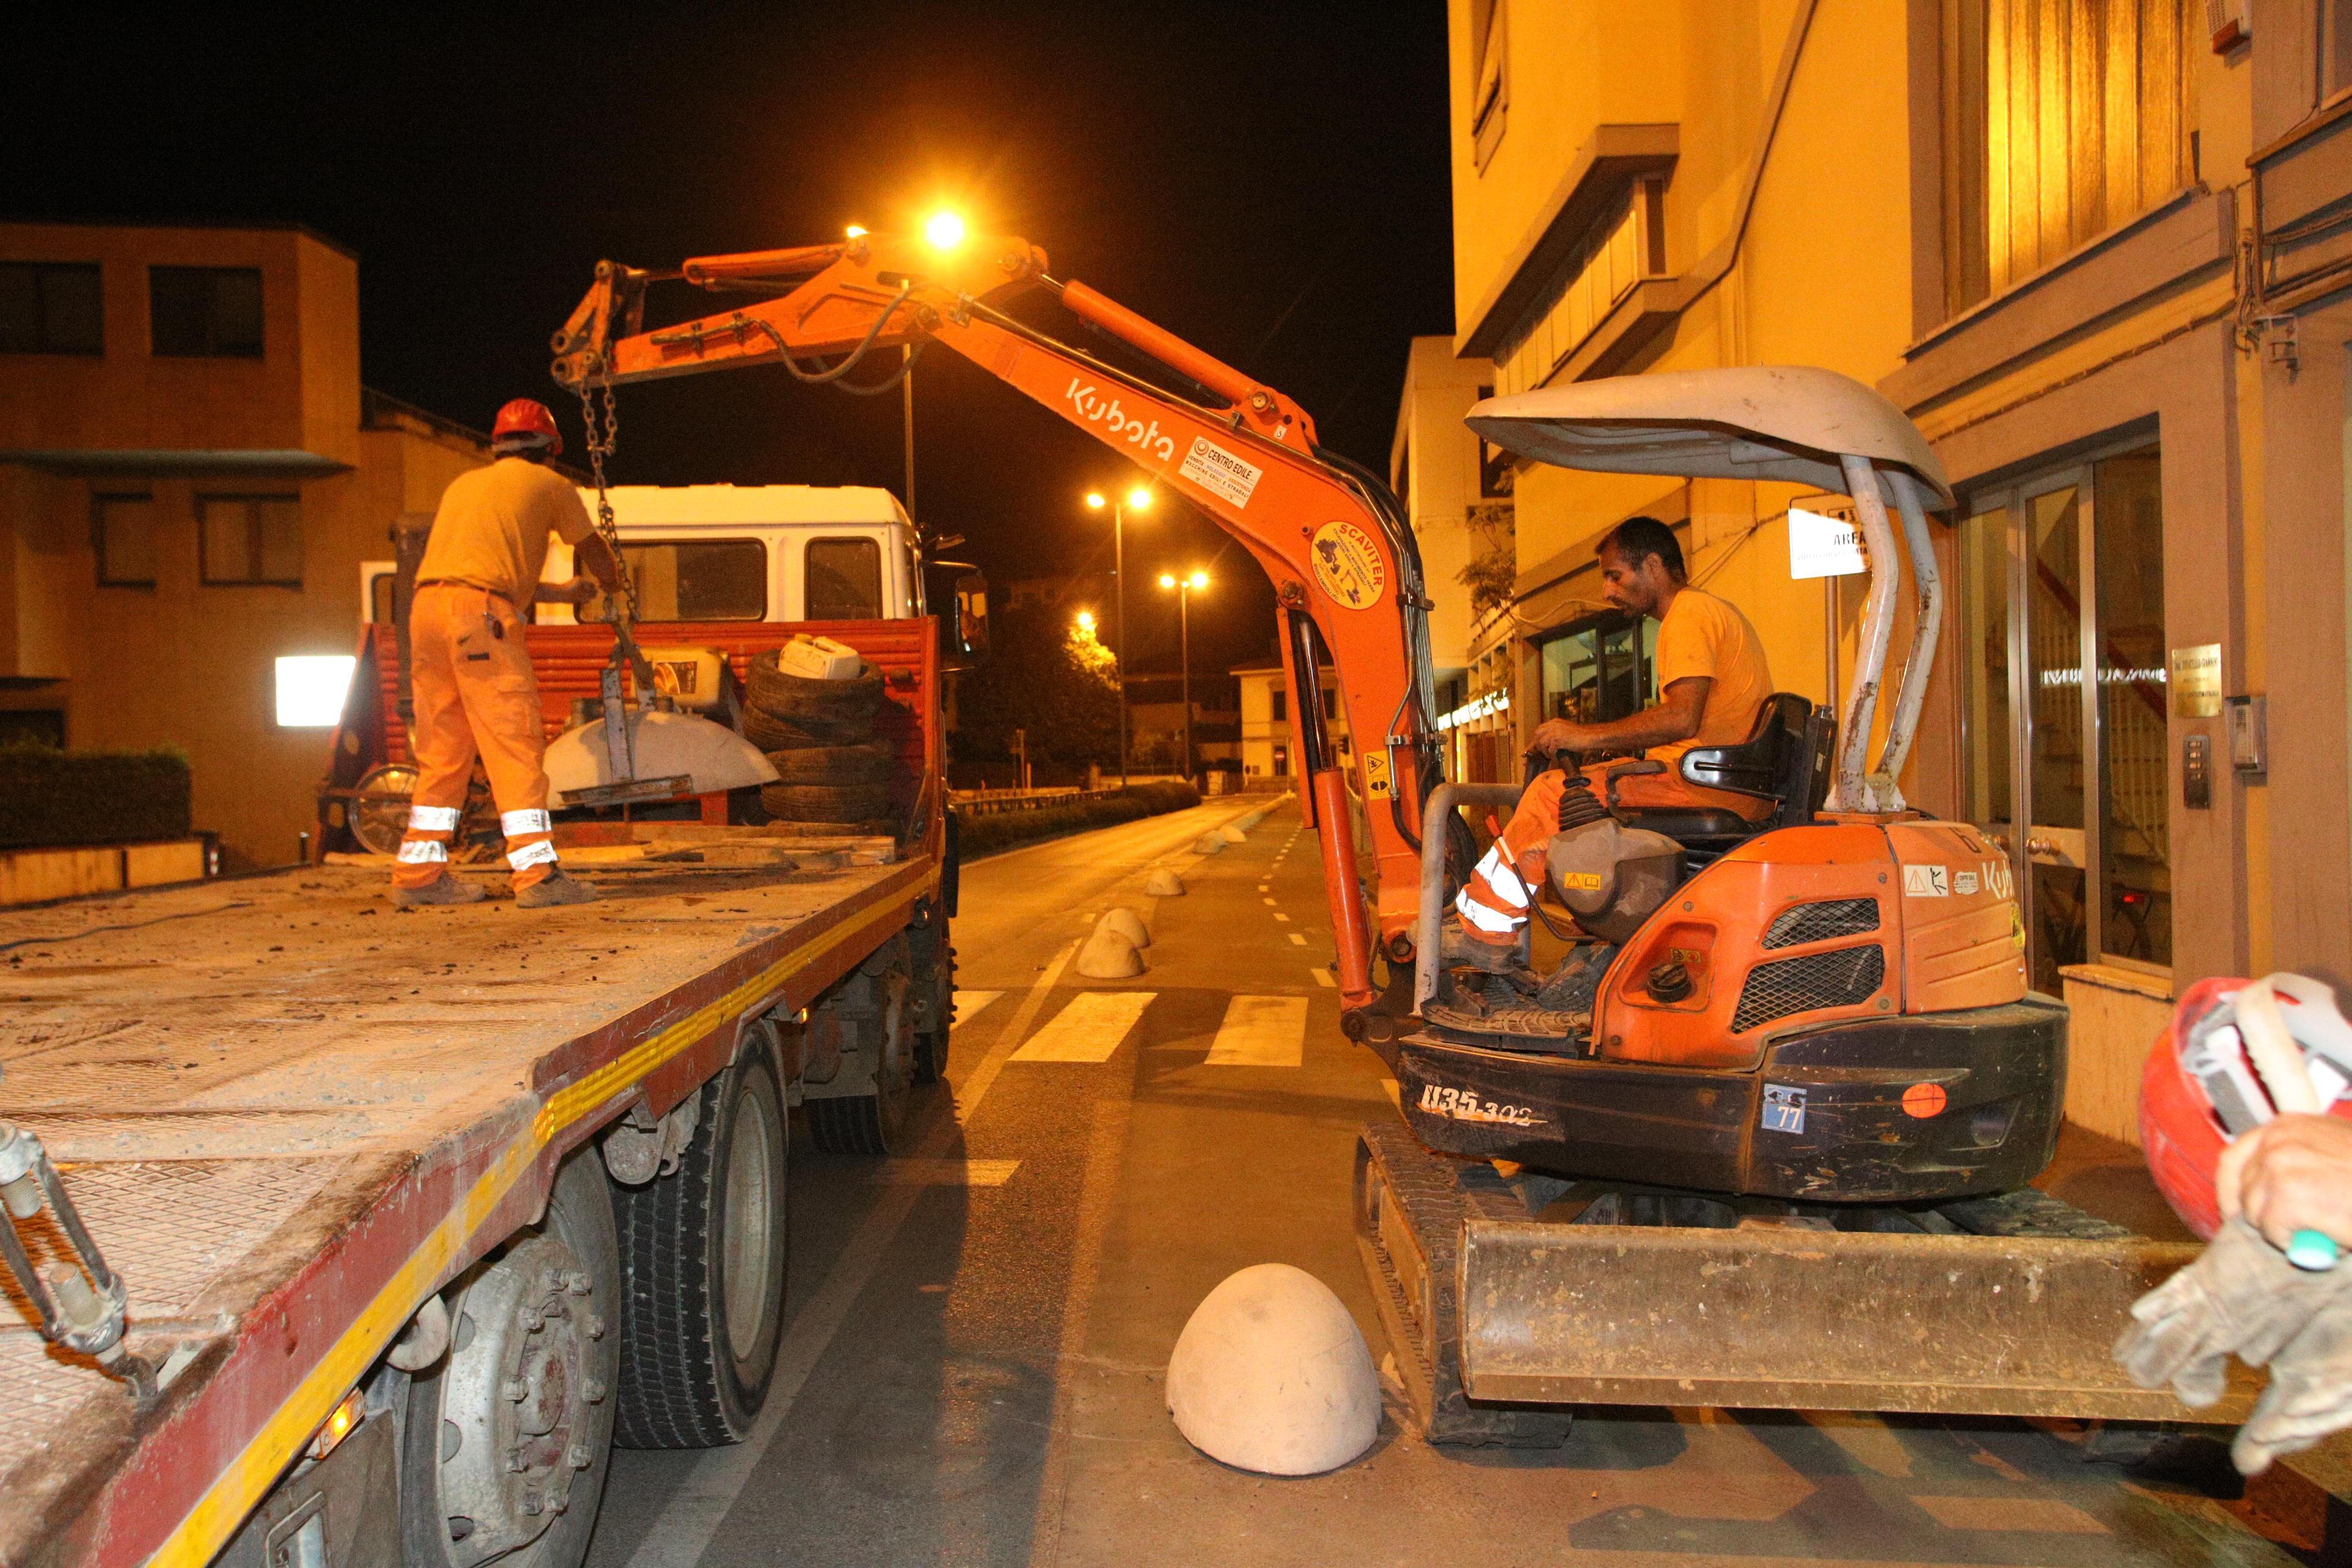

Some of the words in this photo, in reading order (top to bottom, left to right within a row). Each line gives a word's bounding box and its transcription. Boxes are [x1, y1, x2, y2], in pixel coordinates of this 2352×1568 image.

[1066, 378, 1174, 461] Kubota
[1185, 460, 1208, 475] MACCHINE
[1210, 473, 1221, 483] EDILI
[1227, 484, 1249, 498] STRADALI
[1188, 455, 1204, 466] VENDITA
[1228, 478, 1251, 492] ASSISTENZA
[1208, 450, 1234, 469] CENTRO
[1232, 464, 1253, 480] EDILE
[1340, 524, 1382, 586] SCAVITER
[1834, 531, 1866, 546] AREA
[1333, 528, 1350, 553] ESCAVAZIONI
[1351, 556, 1367, 579] MOVIMENTO
[1366, 579, 1375, 593] TERRA
[1335, 540, 1346, 554] LAVORI
[1344, 553, 1352, 564] EDILI
[1353, 567, 1366, 586] STRADALI
[1319, 578, 1332, 595] EMPOLI
[1777, 1106, 1801, 1129] 77
